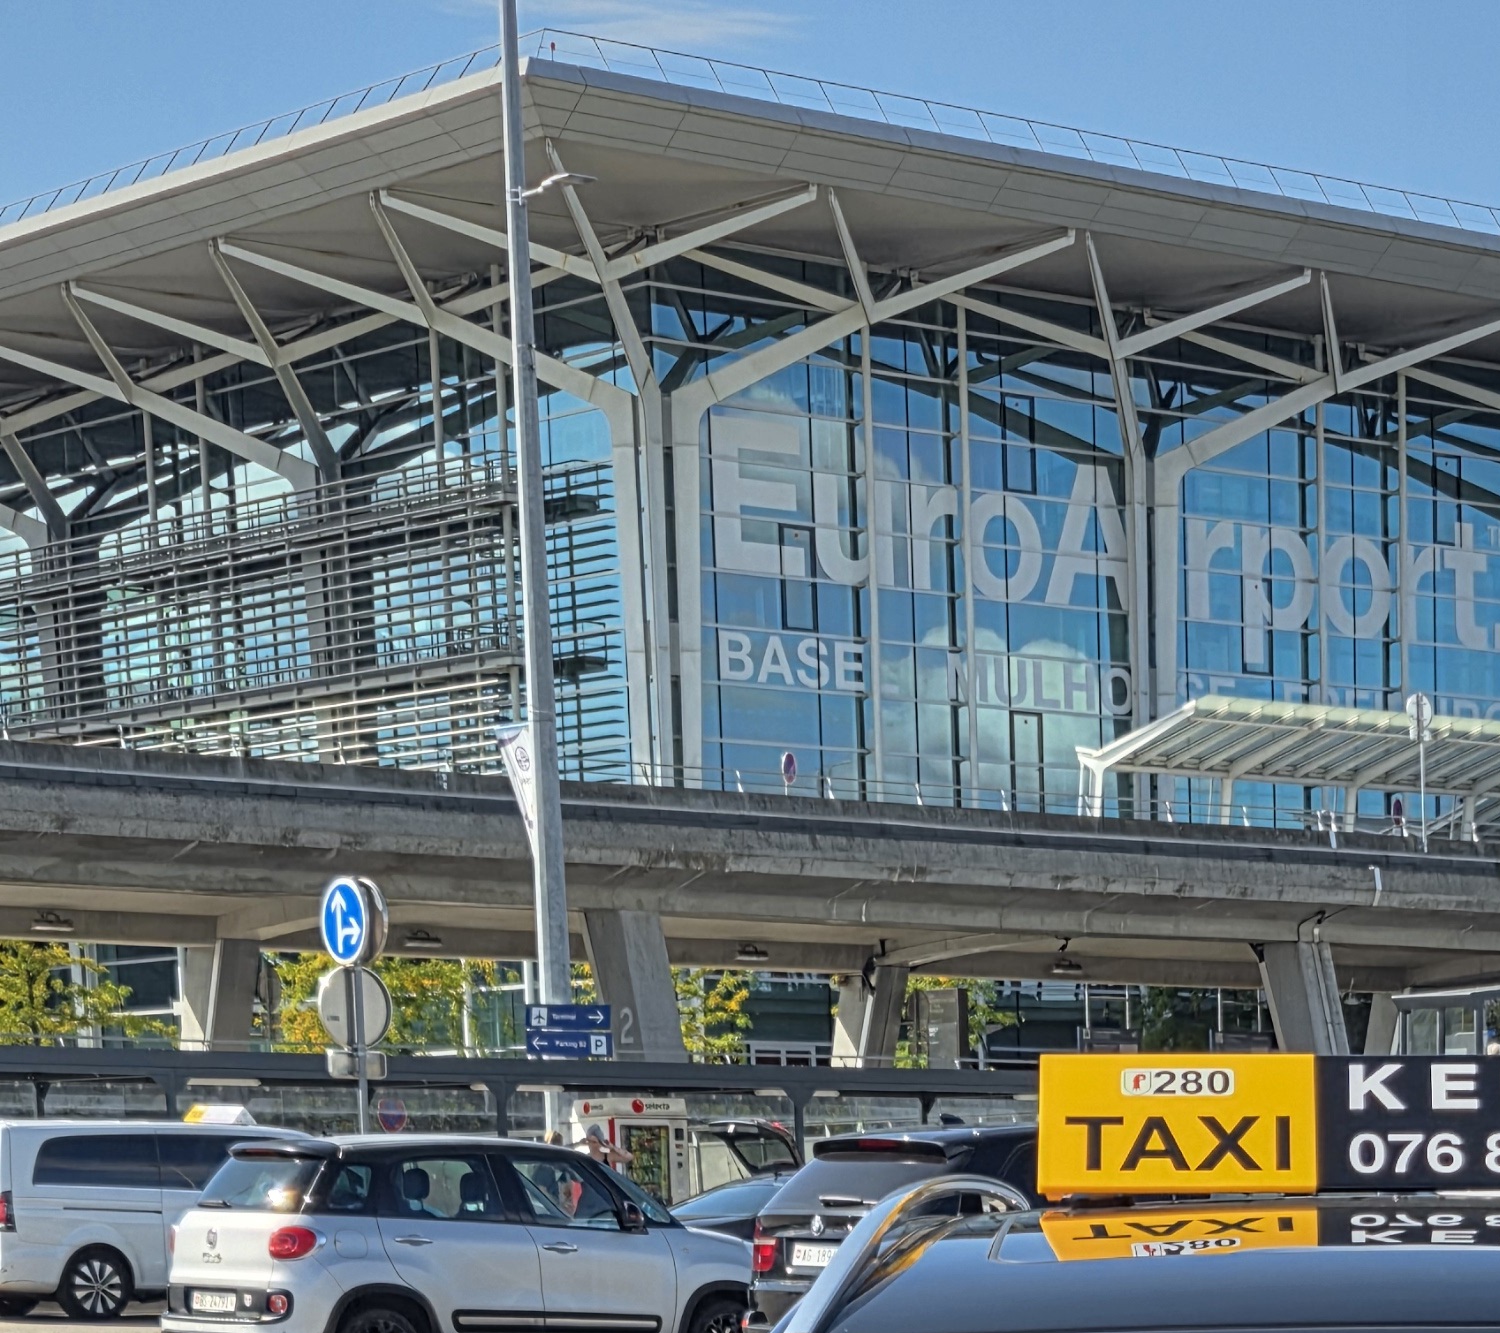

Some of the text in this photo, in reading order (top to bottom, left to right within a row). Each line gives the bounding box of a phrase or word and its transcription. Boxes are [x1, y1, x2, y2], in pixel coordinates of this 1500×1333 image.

[619, 1006, 634, 1044] 2
[595, 1039, 603, 1051] P
[1153, 1070, 1230, 1095] 280
[645, 1102, 670, 1111] selecta
[1065, 1115, 1291, 1172] TAXI
[1348, 1133, 1464, 1175] 076
[802, 1248, 837, 1263] AG 189
